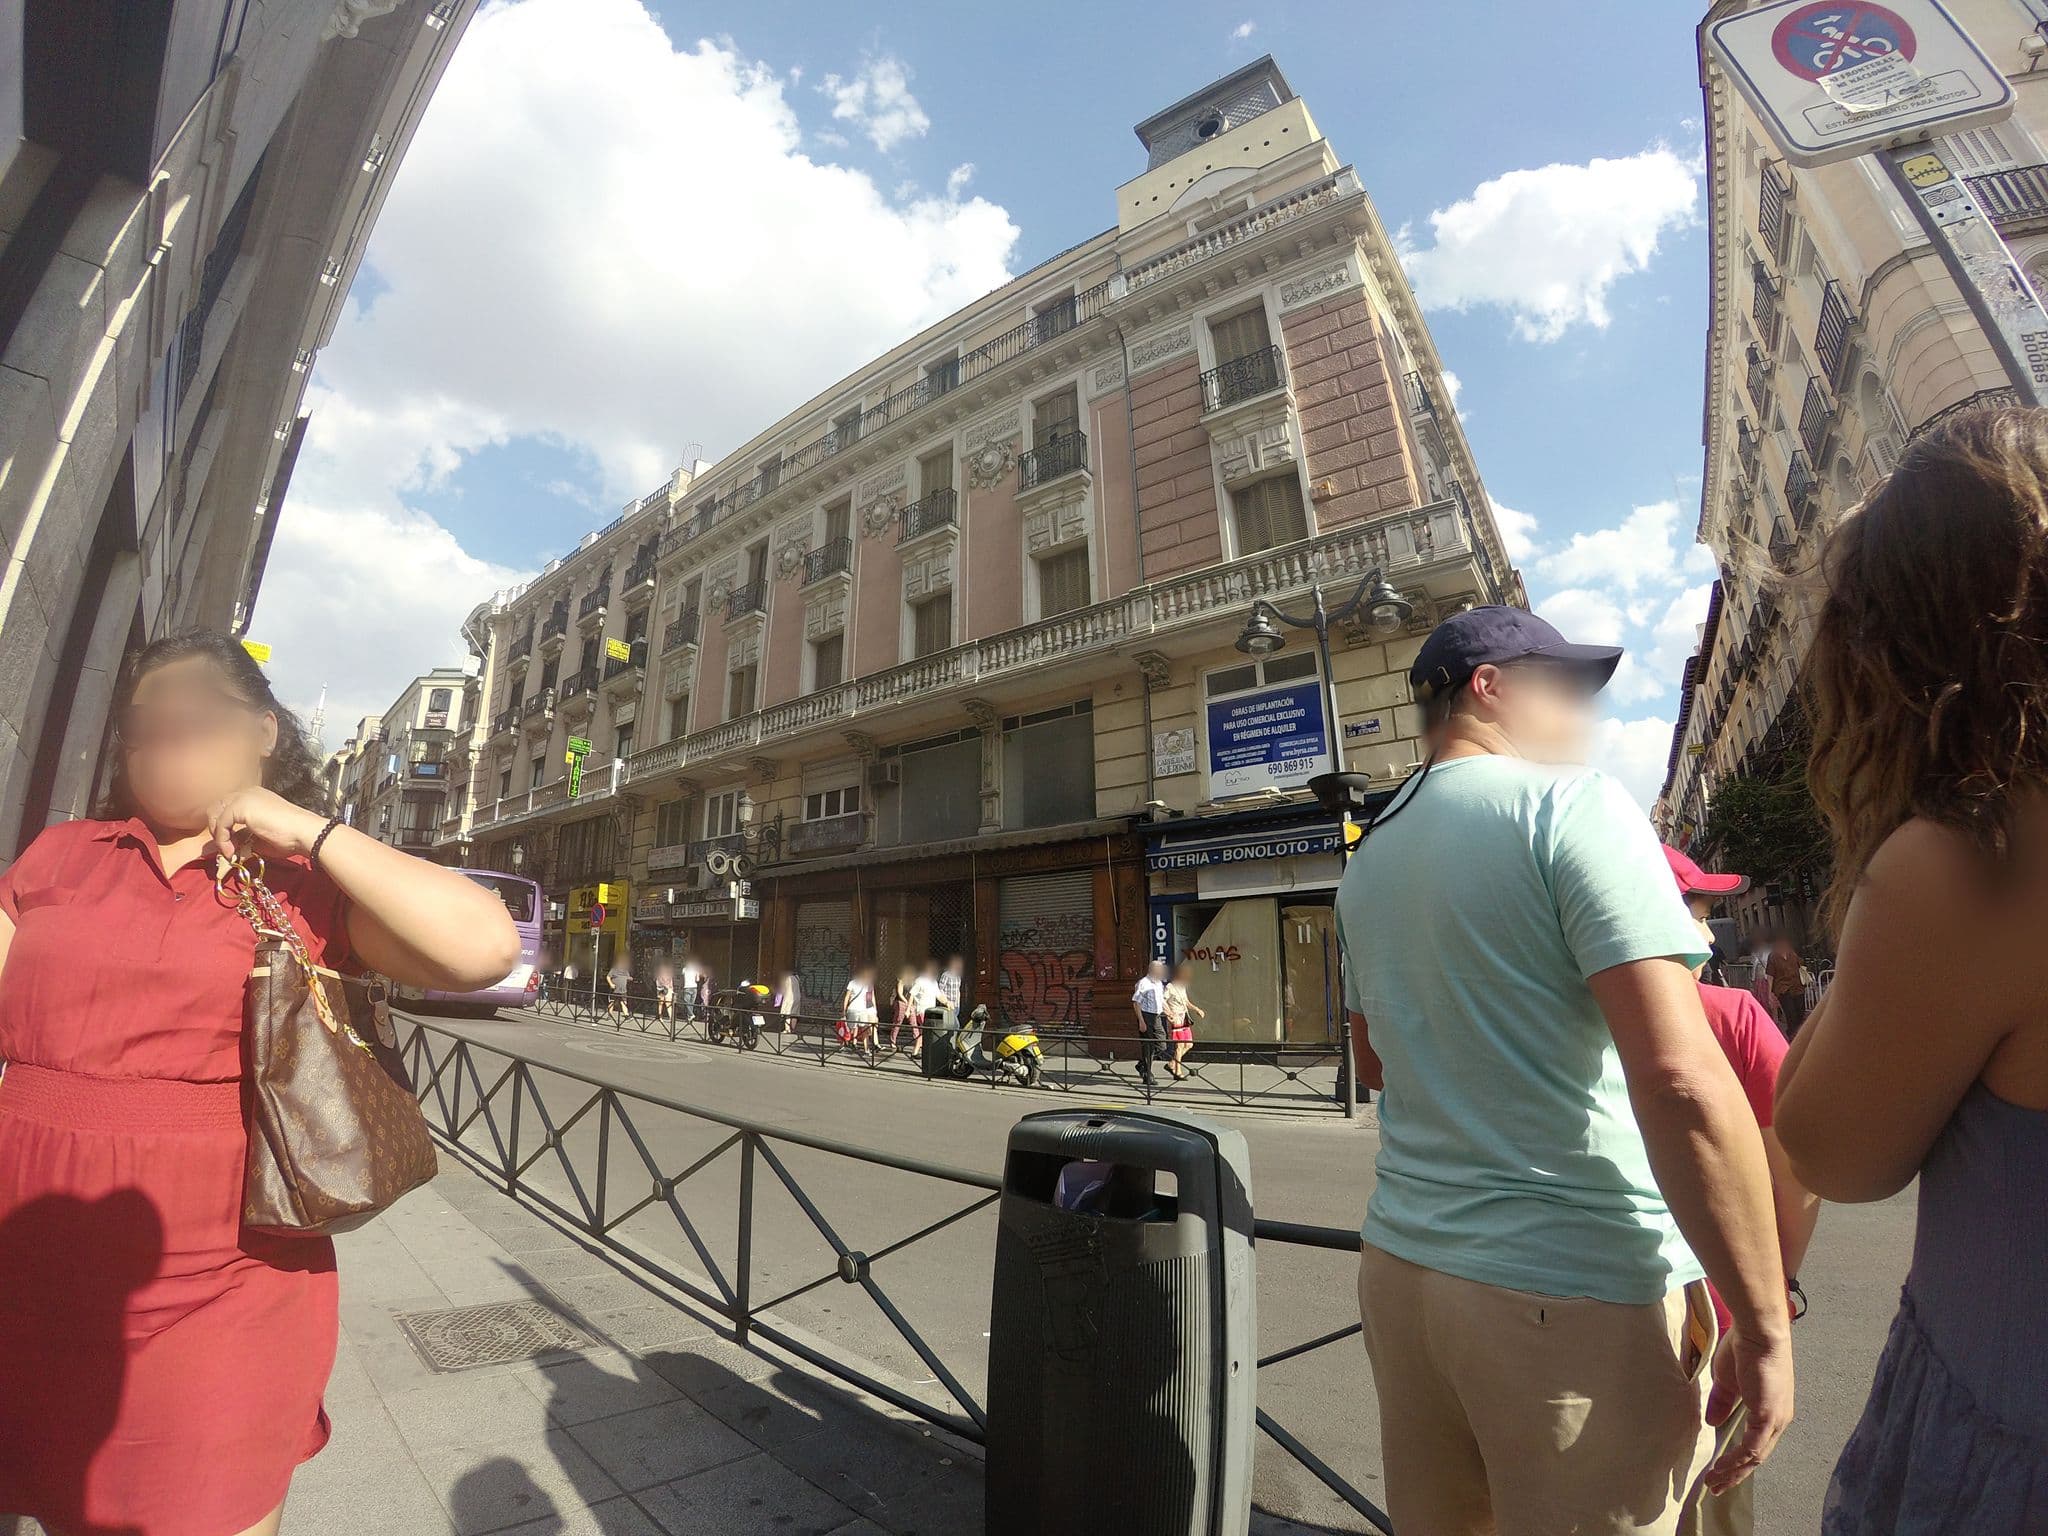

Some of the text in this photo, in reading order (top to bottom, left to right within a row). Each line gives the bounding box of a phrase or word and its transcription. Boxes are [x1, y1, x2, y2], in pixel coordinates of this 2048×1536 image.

[1825, 105, 1909, 129] ESTACIONAMIENTO
[1911, 98, 1935, 109] PARA
[1936, 90, 1968, 101] MOTOS
[2021, 333, 2048, 383] BOOBS
[1231, 697, 1295, 717] OBRAS DE IMPLANTACIÓN
[1223, 708, 1306, 731] PARA USO COMERCIAL EXCLUSIVO
[1233, 722, 1297, 741] EN RÉGIMEN DE ALQUILER
[1268, 763, 1283, 775] 690
[1284, 760, 1298, 773] 869
[1299, 757, 1314, 770] 915
[1151, 852, 1210, 870] LOTERIA
[1223, 840, 1309, 862] BONOLOTO
